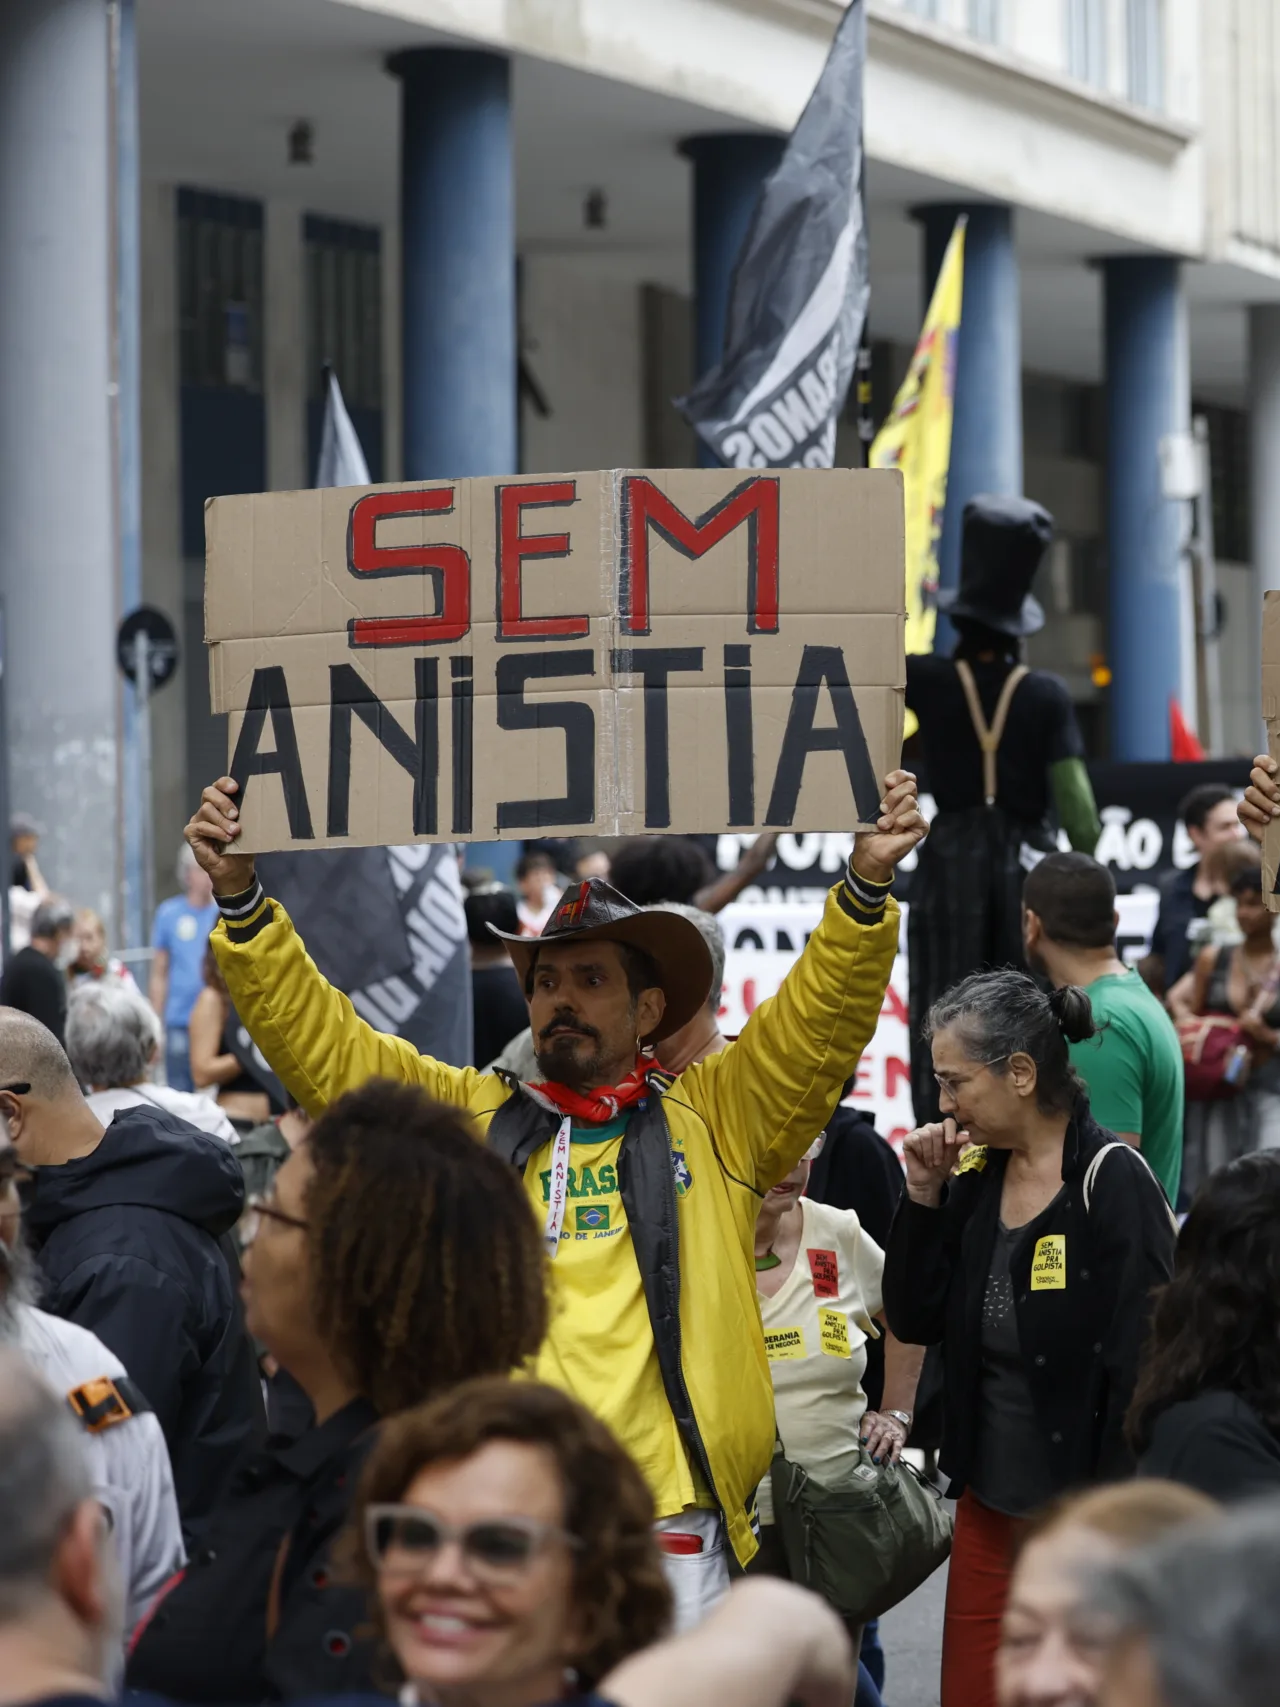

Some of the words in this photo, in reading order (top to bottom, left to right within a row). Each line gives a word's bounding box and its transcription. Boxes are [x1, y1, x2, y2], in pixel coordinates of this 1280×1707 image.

[348, 476, 780, 648] SEM
[558, 1130, 566, 1154] SEM
[1041, 1241, 1053, 1249] SEM
[1034, 1262, 1062, 1271] GOLPISTA
[764, 1331, 799, 1344] BERANIA
[775, 1339, 801, 1349] NEGOCIA
